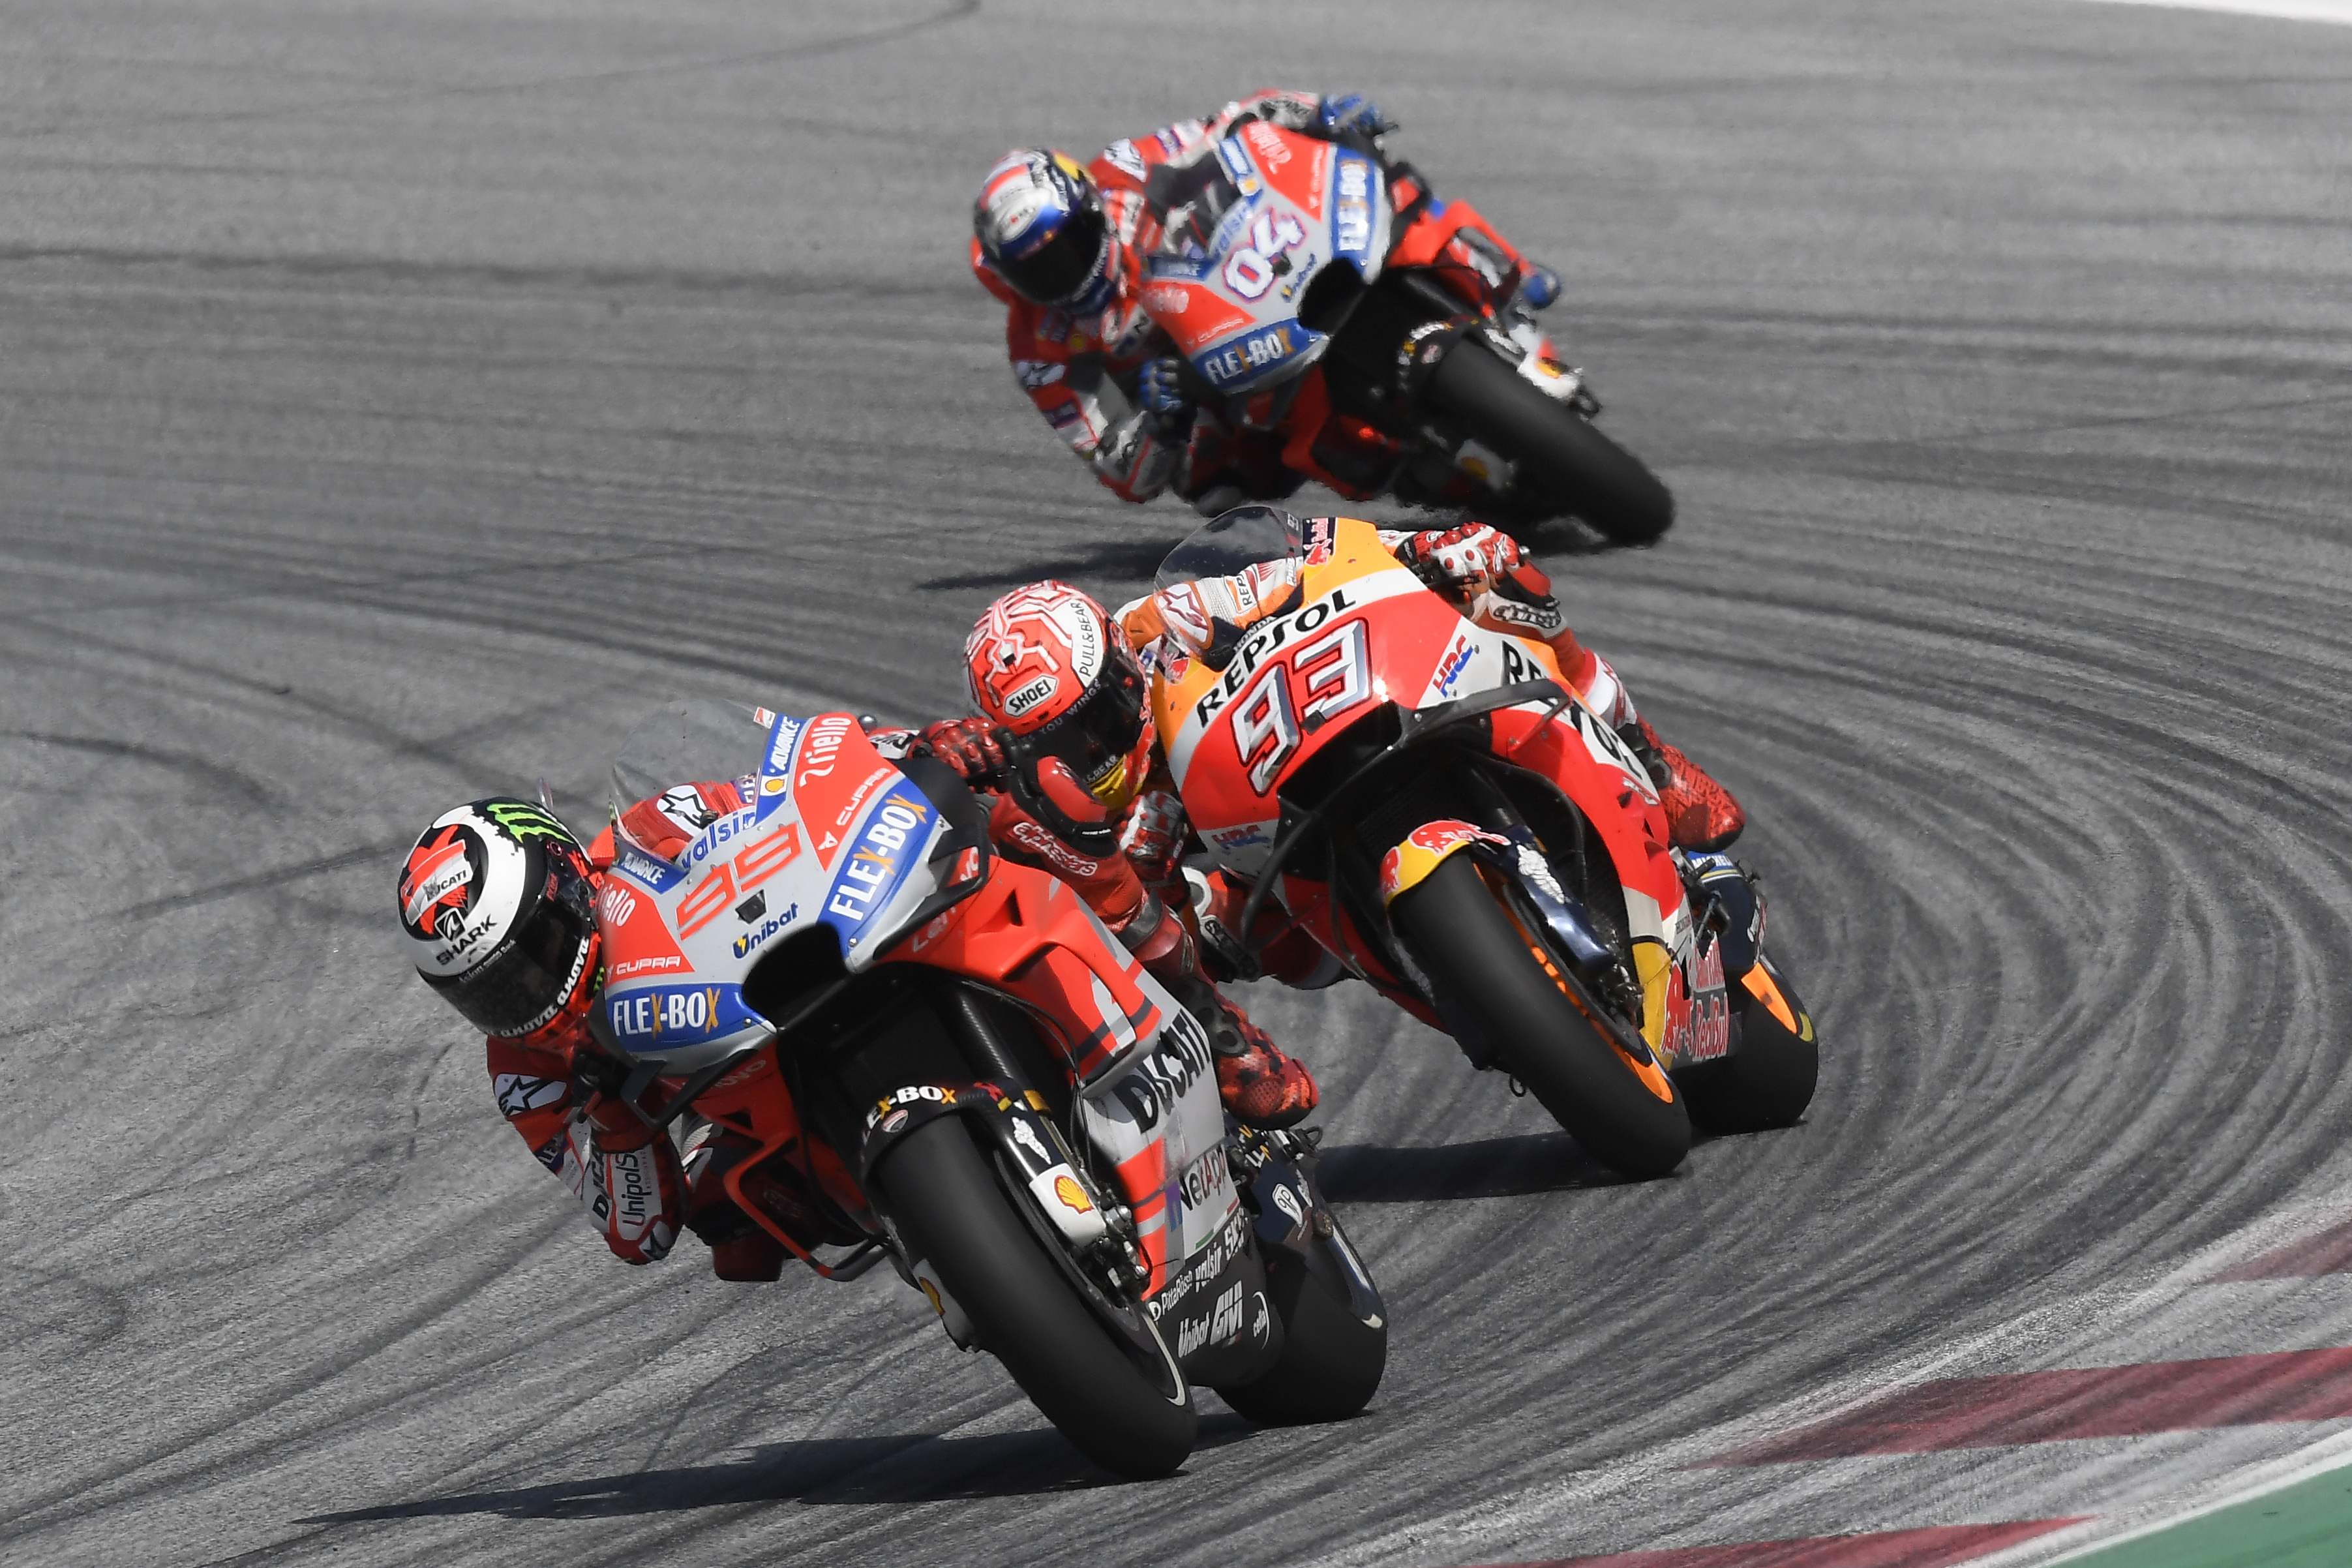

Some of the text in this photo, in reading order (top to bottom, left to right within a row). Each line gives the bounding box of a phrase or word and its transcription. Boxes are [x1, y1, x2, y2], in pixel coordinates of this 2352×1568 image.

[1224, 205, 1307, 303] 04
[1205, 327, 1296, 385] FLEX-BOX
[1070, 601, 1095, 676] PULL&BEAR
[1195, 588, 1357, 729] REPSOL
[1011, 678, 1051, 714] SHOEI
[1039, 680, 1101, 734] YOU WINGS
[1231, 617, 1374, 797] 93
[771, 716, 800, 771] ADVANCE
[837, 768, 892, 826] CUPRA
[674, 822, 804, 941] 99
[828, 793, 927, 921] FLEX-BOX
[435, 913, 498, 965] SHARK
[732, 903, 799, 959] Unibat
[616, 955, 681, 976] CUPRA
[612, 986, 720, 1040] FLEX-BOX
[1111, 1009, 1210, 1135] DUCATI
[616, 1149, 652, 1226] UnipolS
[1178, 1311, 1210, 1359] Unibat
